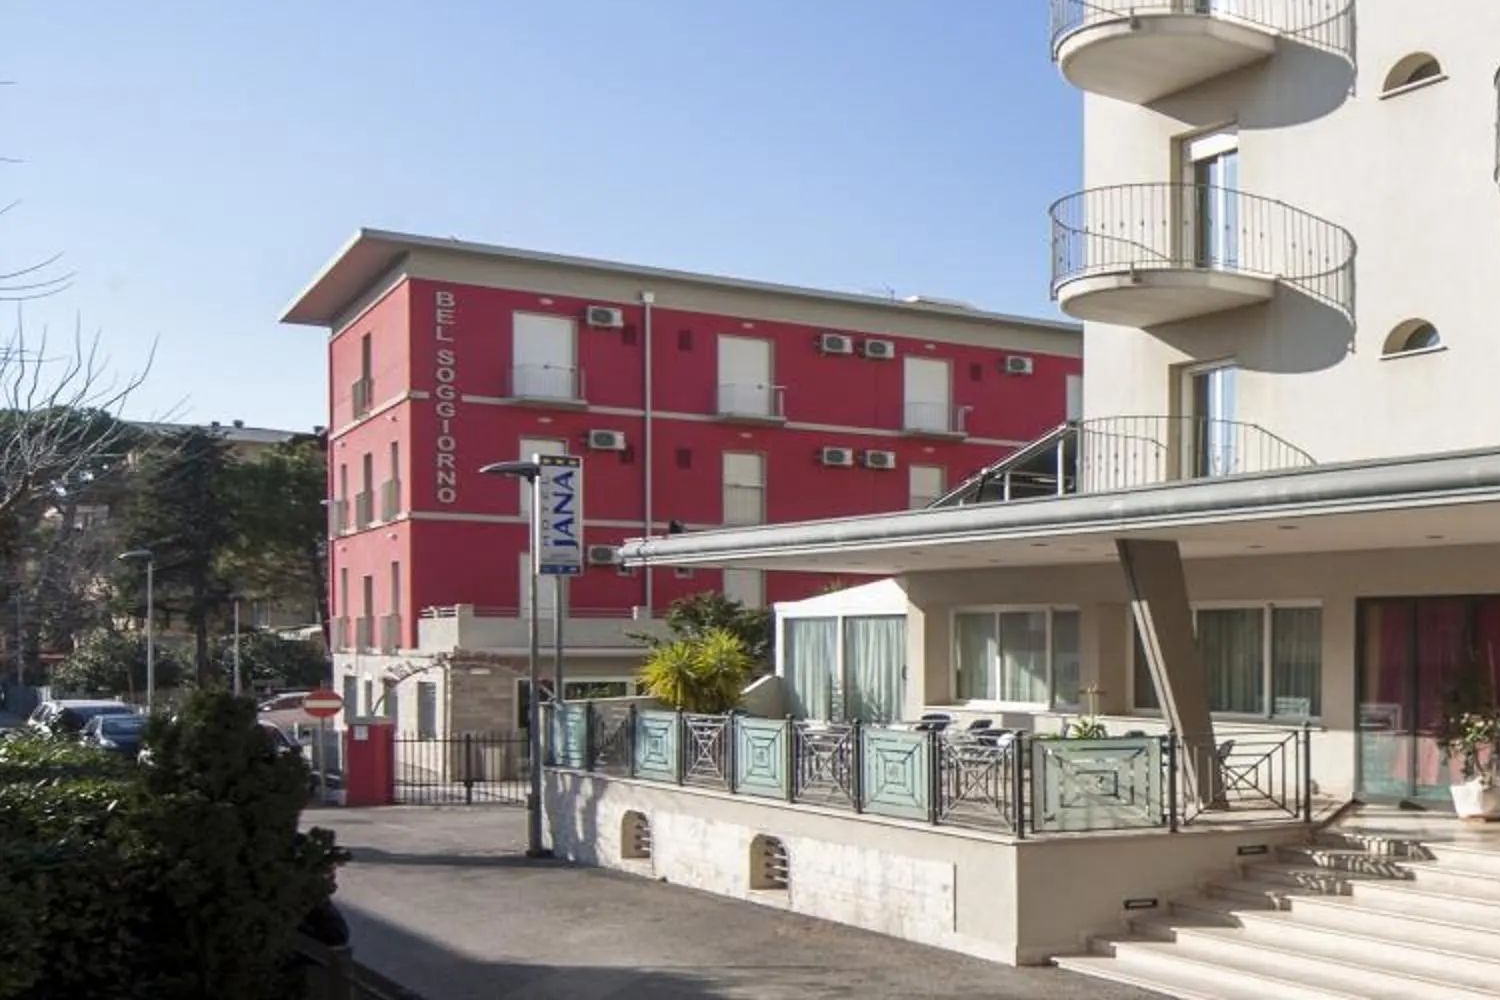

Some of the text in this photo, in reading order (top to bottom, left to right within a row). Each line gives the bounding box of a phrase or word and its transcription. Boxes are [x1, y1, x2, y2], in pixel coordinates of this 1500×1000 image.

[435, 291, 456, 503] BEL SOGGIORNO
[552, 471, 578, 549] JANA
